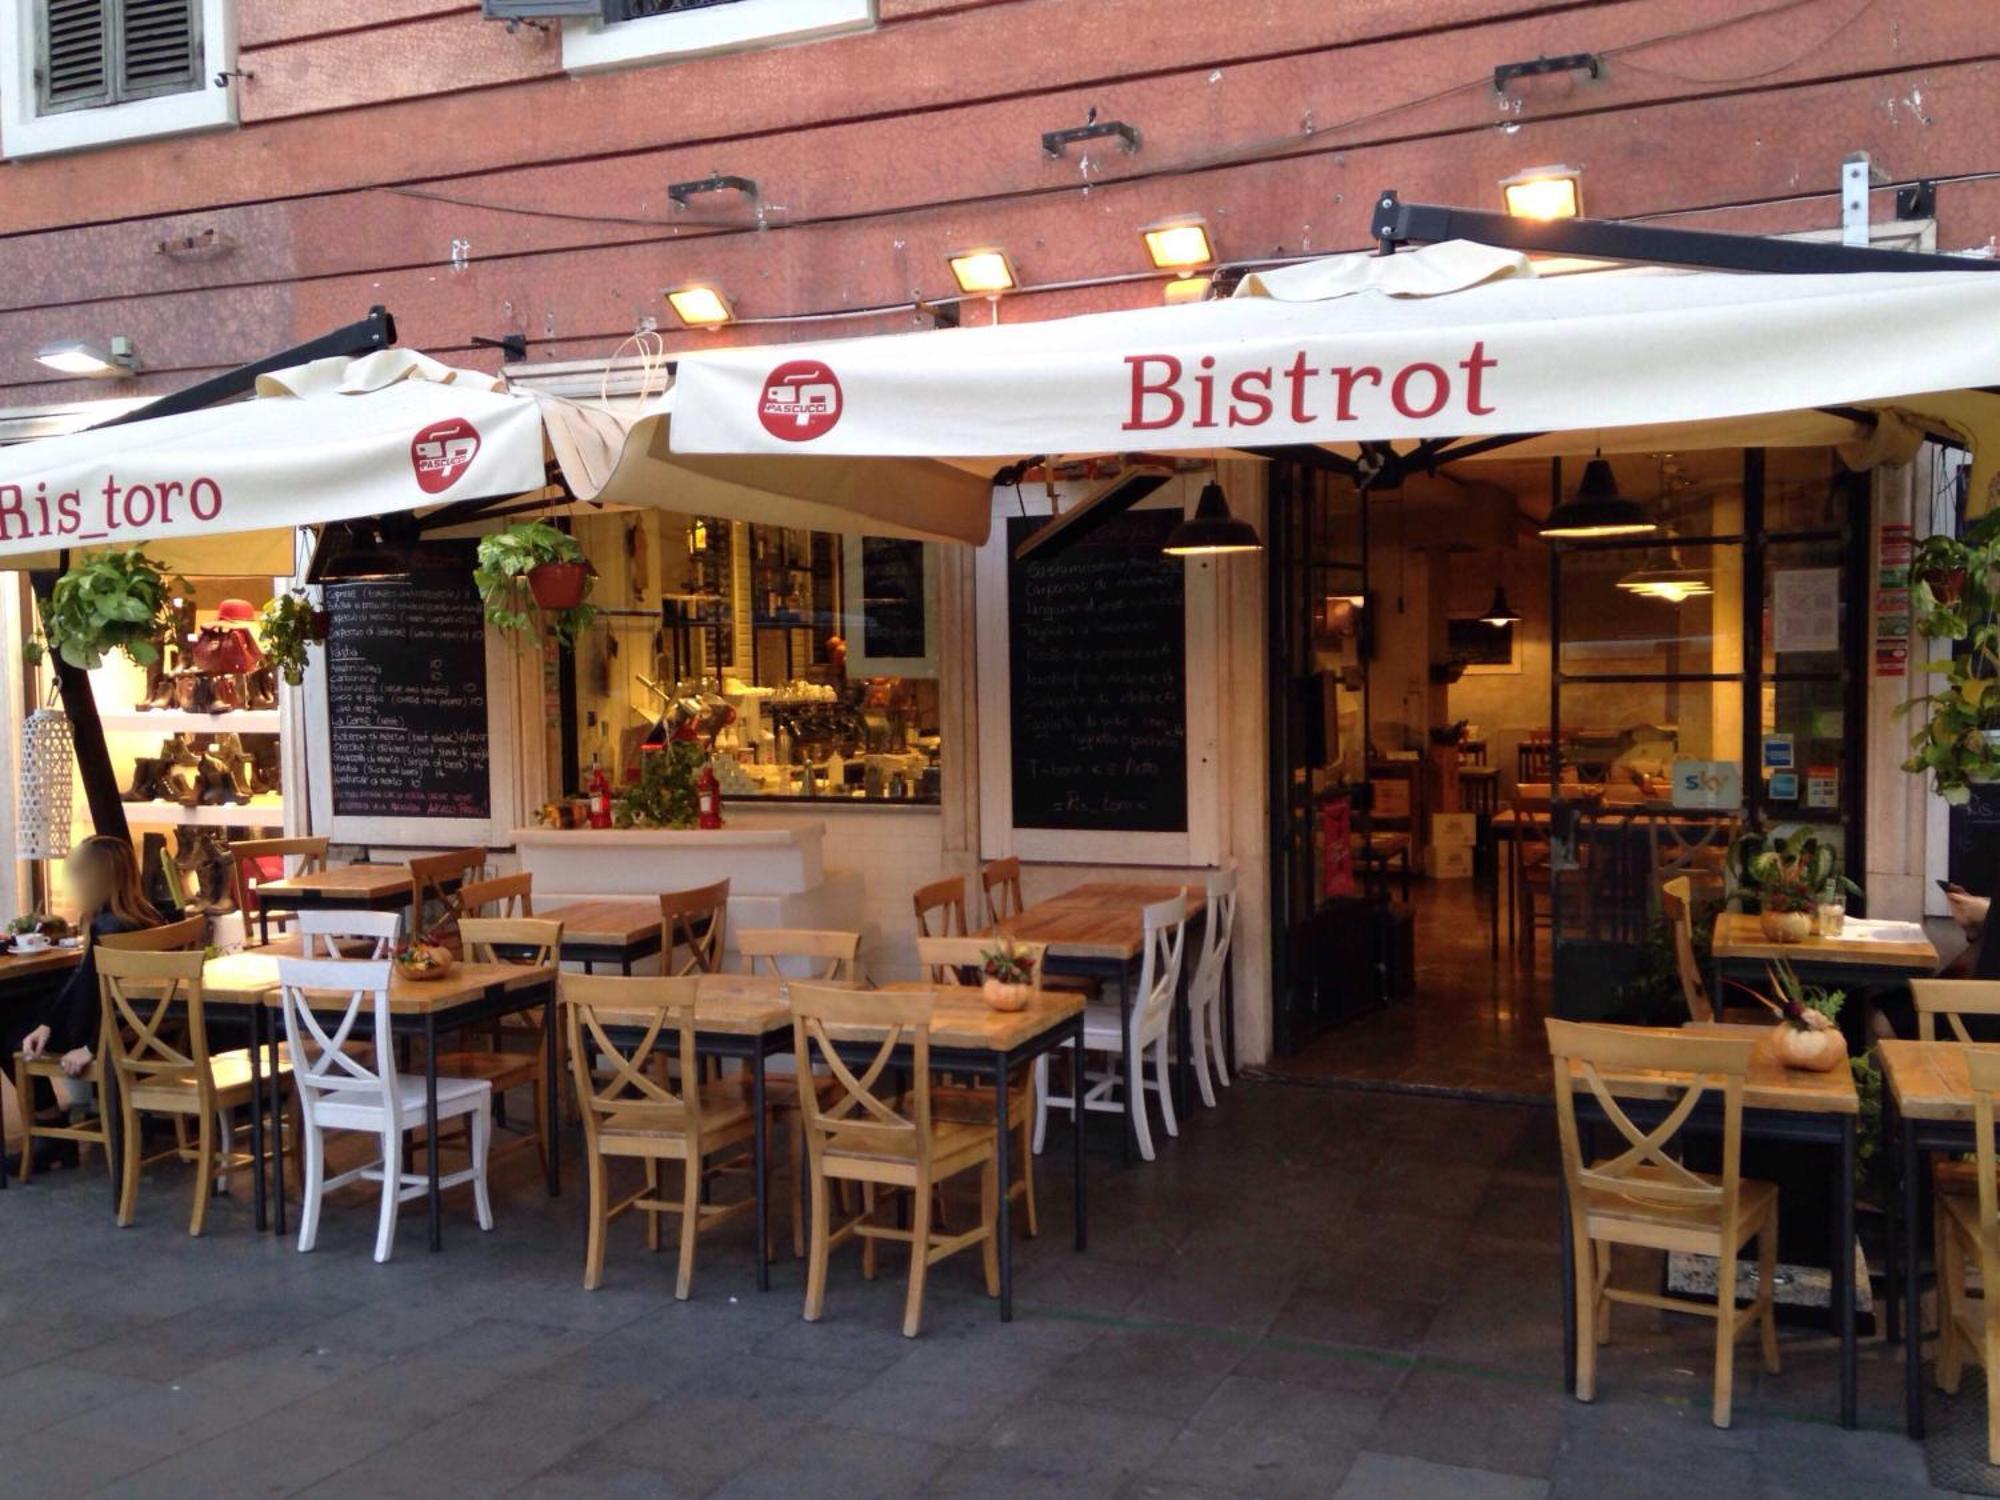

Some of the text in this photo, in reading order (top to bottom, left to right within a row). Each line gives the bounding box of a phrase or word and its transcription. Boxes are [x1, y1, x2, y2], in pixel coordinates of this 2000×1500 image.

[764, 403, 827, 414] PASCUCCI
[1122, 341, 1496, 430] Bistrot
[0, 474, 223, 541] Ris_toro
[1685, 770, 1729, 797] sky
